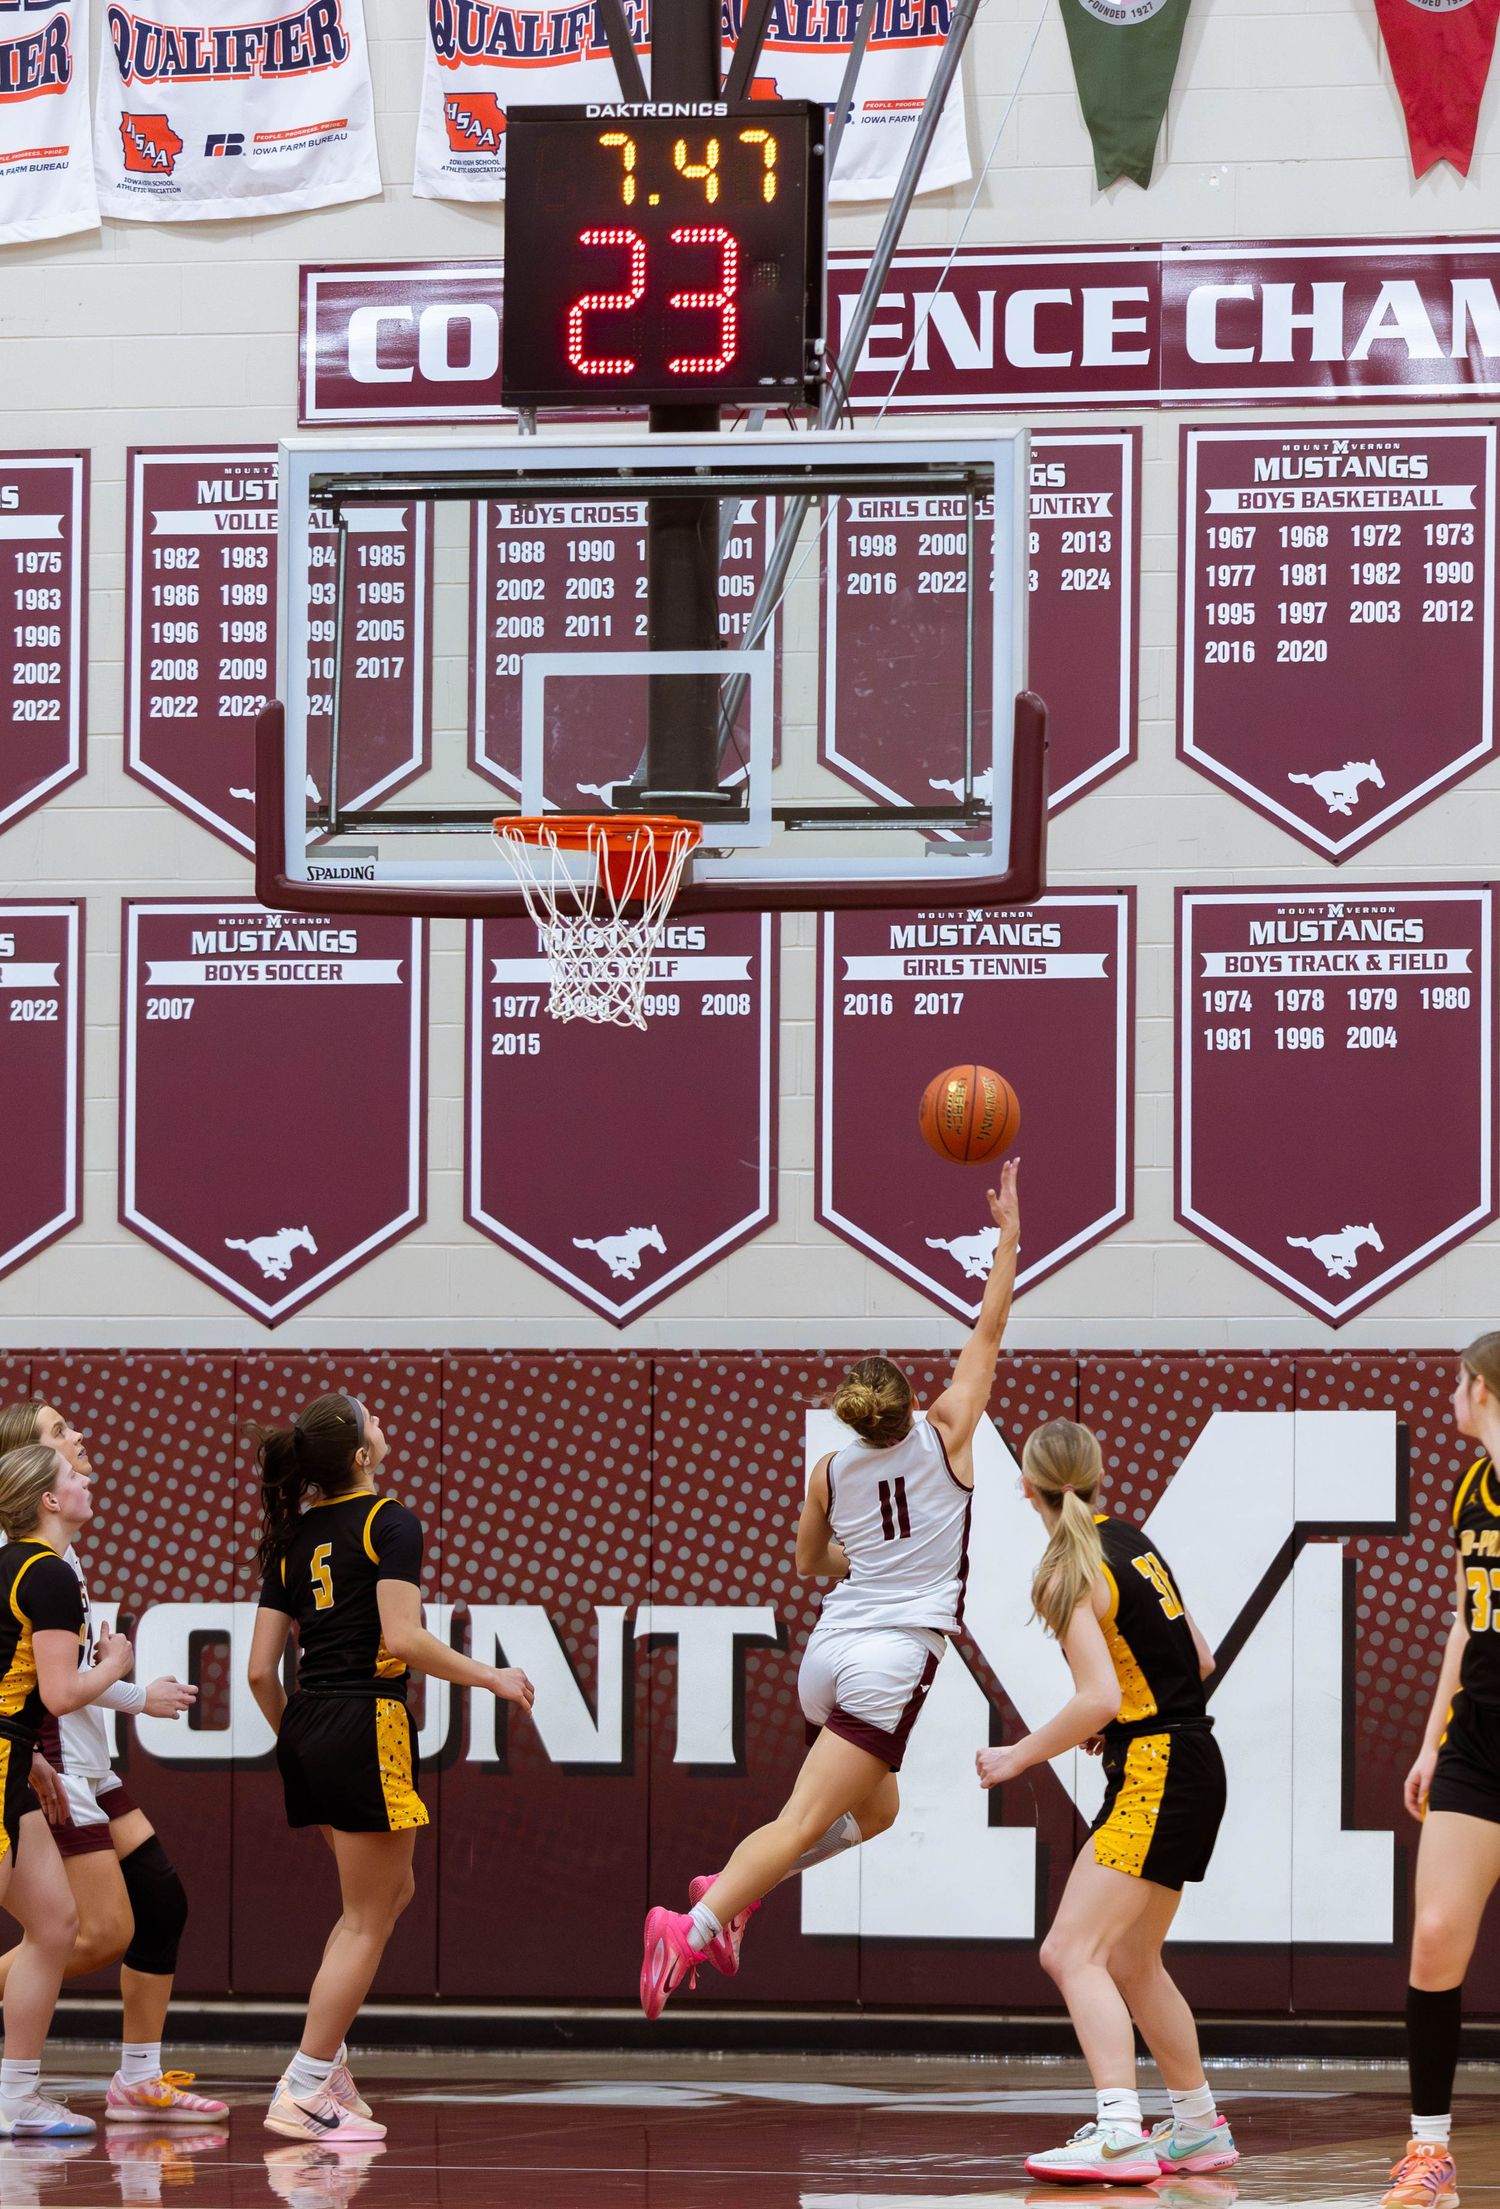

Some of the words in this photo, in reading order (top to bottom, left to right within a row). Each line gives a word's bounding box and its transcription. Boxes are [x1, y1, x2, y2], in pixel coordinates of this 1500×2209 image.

[1131, 2, 1153, 18] 1927
[107, 0, 349, 80] QUALIFIER
[586, 103, 728, 118] DAKTRONICS
[861, 116, 887, 124] IOWA
[888, 115, 915, 123] FARM
[253, 147, 277, 156] IOWA
[280, 142, 306, 153] FARM
[308, 133, 348, 148] BUREAU
[29, 162, 70, 172] BUREAU
[568, 228, 737, 374] 23
[1254, 455, 1428, 482] MUSTANGS
[859, 501, 918, 518] GIRLS
[1238, 492, 1294, 509] BOYS
[1302, 490, 1443, 508] BASKETBALL
[510, 504, 565, 525] BOYS
[571, 506, 638, 523] CROSS
[848, 535, 896, 556] 1998
[919, 534, 966, 555] 2000
[1062, 531, 1111, 553] 2013
[1207, 527, 1256, 548] 1967
[1279, 526, 1328, 547] 1968
[1351, 524, 1401, 546] 1972
[1424, 523, 1473, 545] 1973
[15, 552, 61, 573] 1975
[153, 548, 199, 569] 1982
[221, 547, 267, 568] 1983
[358, 545, 405, 566] 1985
[498, 541, 544, 563] 1988
[567, 540, 614, 561] 1990
[847, 573, 896, 594] 2016
[918, 572, 966, 593] 2022
[1061, 569, 1110, 590] 2024
[1206, 565, 1255, 586] 1977
[1280, 564, 1326, 585] 1981
[1351, 563, 1400, 585] 1982
[1424, 562, 1473, 583] 1990
[152, 585, 198, 606] 1986
[221, 584, 267, 605] 1989
[358, 583, 404, 603] 1995
[497, 579, 544, 600] 2002
[566, 578, 614, 599] 2003
[718, 575, 755, 597] 005
[15, 589, 60, 610] 1983
[1206, 603, 1255, 624] 1995
[1278, 602, 1327, 624] 1997
[1350, 601, 1400, 623] 2003
[1423, 600, 1473, 622] 2012
[14, 626, 60, 647] 1996
[152, 622, 198, 643] 1996
[220, 621, 266, 642] 1998
[356, 620, 404, 641] 2005
[496, 616, 544, 637] 2008
[566, 616, 611, 637] 2011
[1205, 641, 1255, 663] 2016
[1277, 640, 1327, 662] 2020
[13, 663, 60, 684] 2002
[151, 659, 198, 680] 2008
[219, 659, 266, 679] 2009
[356, 657, 404, 678] 2017
[13, 700, 60, 721] 2022
[150, 696, 198, 717] 2022
[218, 695, 267, 717] 2023
[306, 865, 375, 881] SPALDING
[192, 930, 357, 954] MUSTANGS
[891, 924, 1060, 949] MUSTANGS
[1250, 919, 1423, 945] MUSTANGS
[205, 965, 258, 981] BOYS
[266, 964, 342, 980] SOCCER
[904, 959, 963, 975] GIRLS
[970, 958, 1046, 975] TENNIS
[1226, 956, 1281, 973] BOYS
[1288, 955, 1359, 972] TRACK
[1366, 954, 1382, 970] &
[1389, 953, 1447, 970] FIELD
[11, 1000, 57, 1021] 2022
[147, 998, 194, 1019] 2007
[493, 996, 540, 1017] 1977
[702, 994, 750, 1015] 2008
[844, 994, 892, 1015] 2016
[915, 993, 963, 1014] 2017
[1203, 990, 1252, 1012] 1974
[1275, 989, 1324, 1011] 1978
[1347, 988, 1397, 1010] 1979
[1420, 987, 1470, 1009] 1980
[492, 1034, 540, 1054] 2015
[1204, 1028, 1250, 1050] 1981
[1275, 1027, 1324, 1049] 1996
[1347, 1027, 1397, 1048] 2004
[878, 1476, 911, 1541] 11
[310, 1541, 335, 1610] 5
